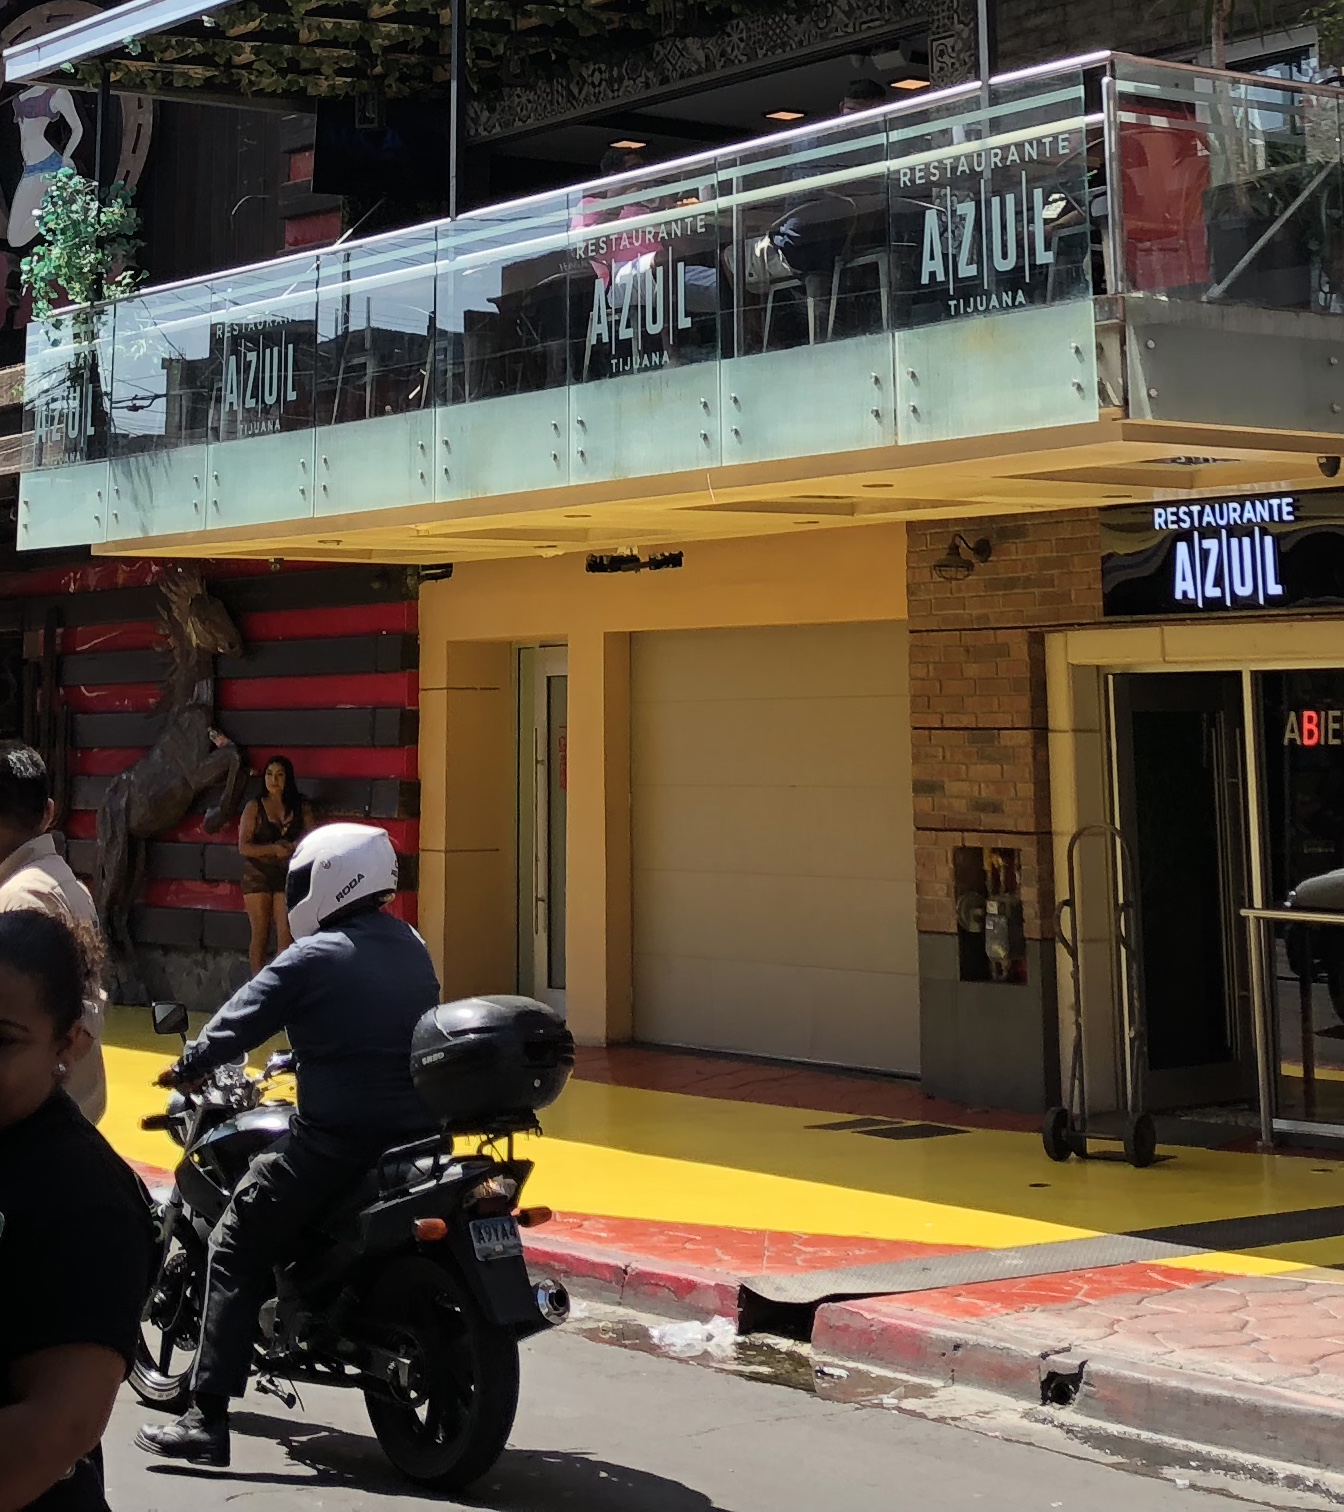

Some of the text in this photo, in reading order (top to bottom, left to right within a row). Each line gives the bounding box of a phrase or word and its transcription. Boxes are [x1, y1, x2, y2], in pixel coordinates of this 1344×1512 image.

[899, 134, 1071, 188] RESTAURANTE
[575, 214, 707, 260] RESTAURANTE
[947, 288, 1027, 316] TIJUANA
[610, 350, 671, 373] TIJUANA
[239, 418, 281, 436] TIJUANA
[1153, 497, 1296, 531] RESTAURANTE
